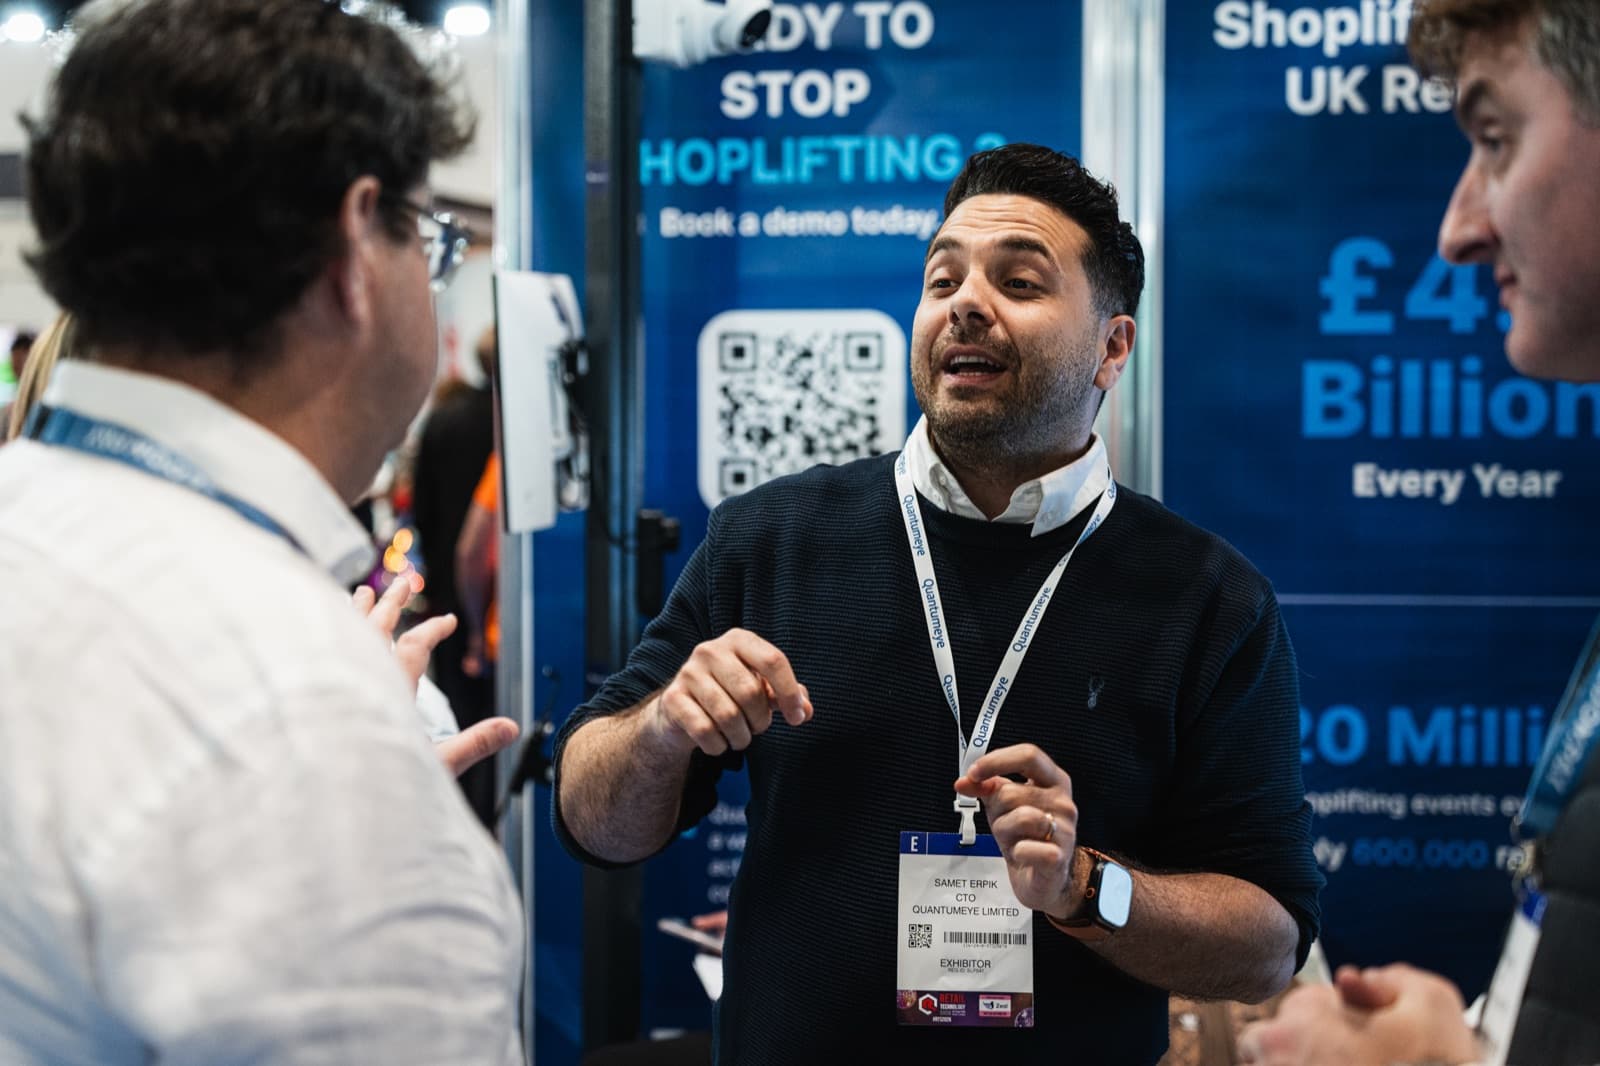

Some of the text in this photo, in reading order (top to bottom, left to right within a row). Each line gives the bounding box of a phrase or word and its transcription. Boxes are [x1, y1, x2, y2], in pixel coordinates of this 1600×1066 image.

[766, 1, 935, 51] DY TO
[1212, 0, 1412, 58] Shoplif
[720, 68, 871, 120] STOP
[1285, 65, 1370, 116] UK
[639, 132, 963, 186] HOPLIFTING
[659, 207, 735, 238] Book
[738, 211, 761, 237] a
[762, 206, 849, 237] demo
[1318, 236, 1513, 334] £4.
[1352, 462, 1562, 505] Every Year
[903, 494, 925, 557] Quantumeye
[921, 578, 945, 649] Quantumeye
[1012, 586, 1052, 653] Quantumeye
[972, 676, 1009, 748] Quantumeye
[1387, 705, 1545, 766] Milli
[1410, 793, 1497, 817] events
[910, 835, 919, 853] E
[934, 878, 998, 889] SAMET ERPIK
[955, 893, 977, 903] CTO
[912, 904, 1020, 917] QUANTUMEYE LIMITED
[940, 959, 991, 969] EXHIBITOR
